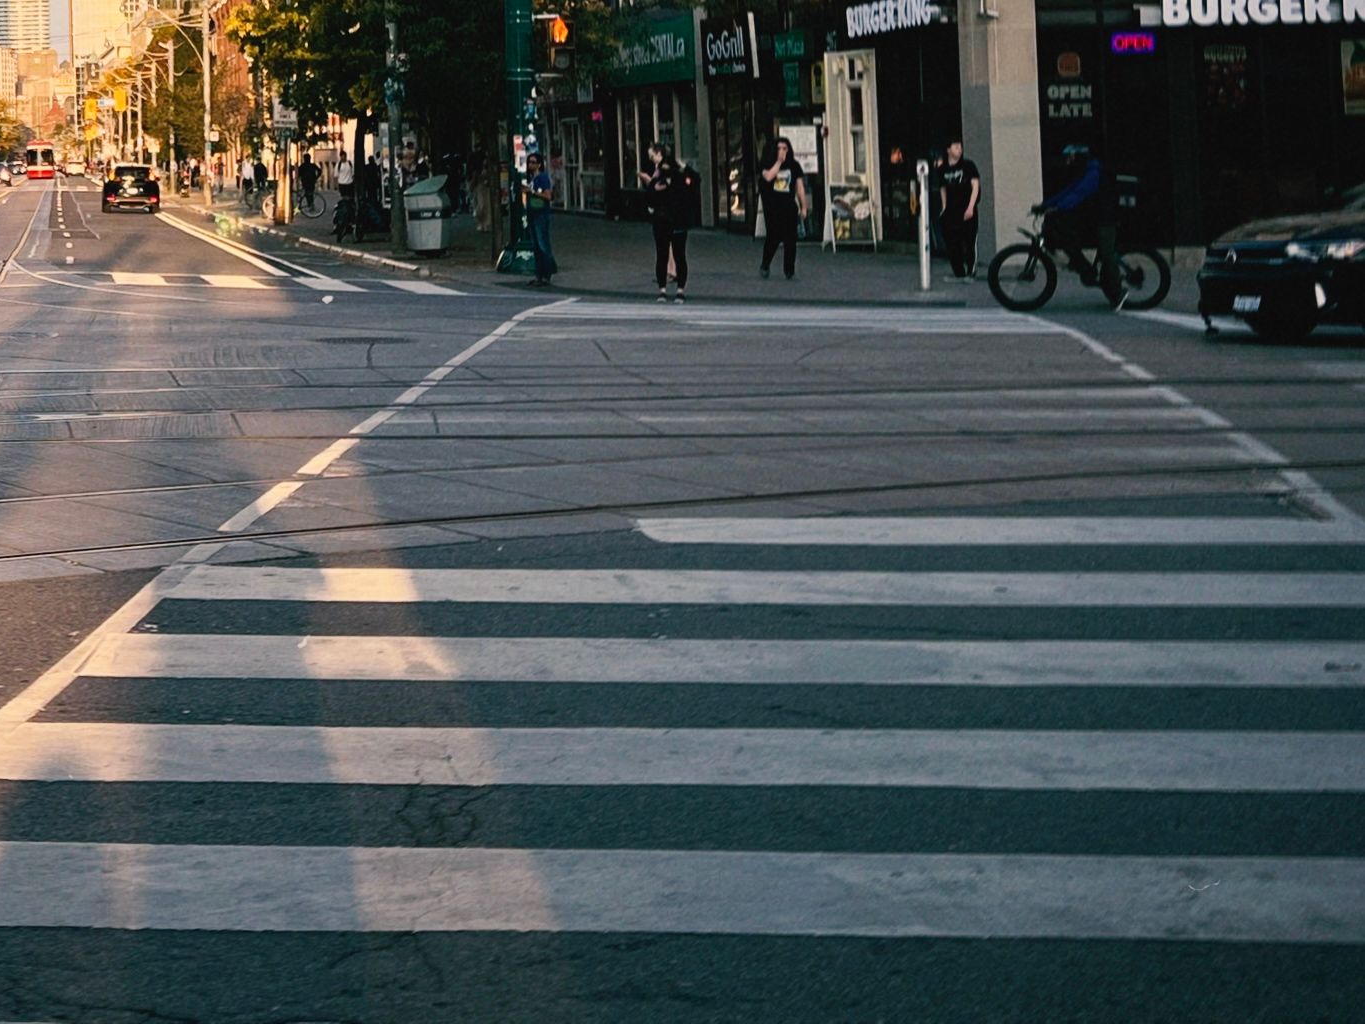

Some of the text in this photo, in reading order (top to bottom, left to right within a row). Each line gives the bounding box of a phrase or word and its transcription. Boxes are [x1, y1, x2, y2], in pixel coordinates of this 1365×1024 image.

[846, 0, 895, 38] BURGER
[707, 24, 744, 61] GoGrill
[1114, 34, 1154, 50] OPEN
[1047, 85, 1092, 99] OPEN
[1048, 103, 1093, 118] LATE
